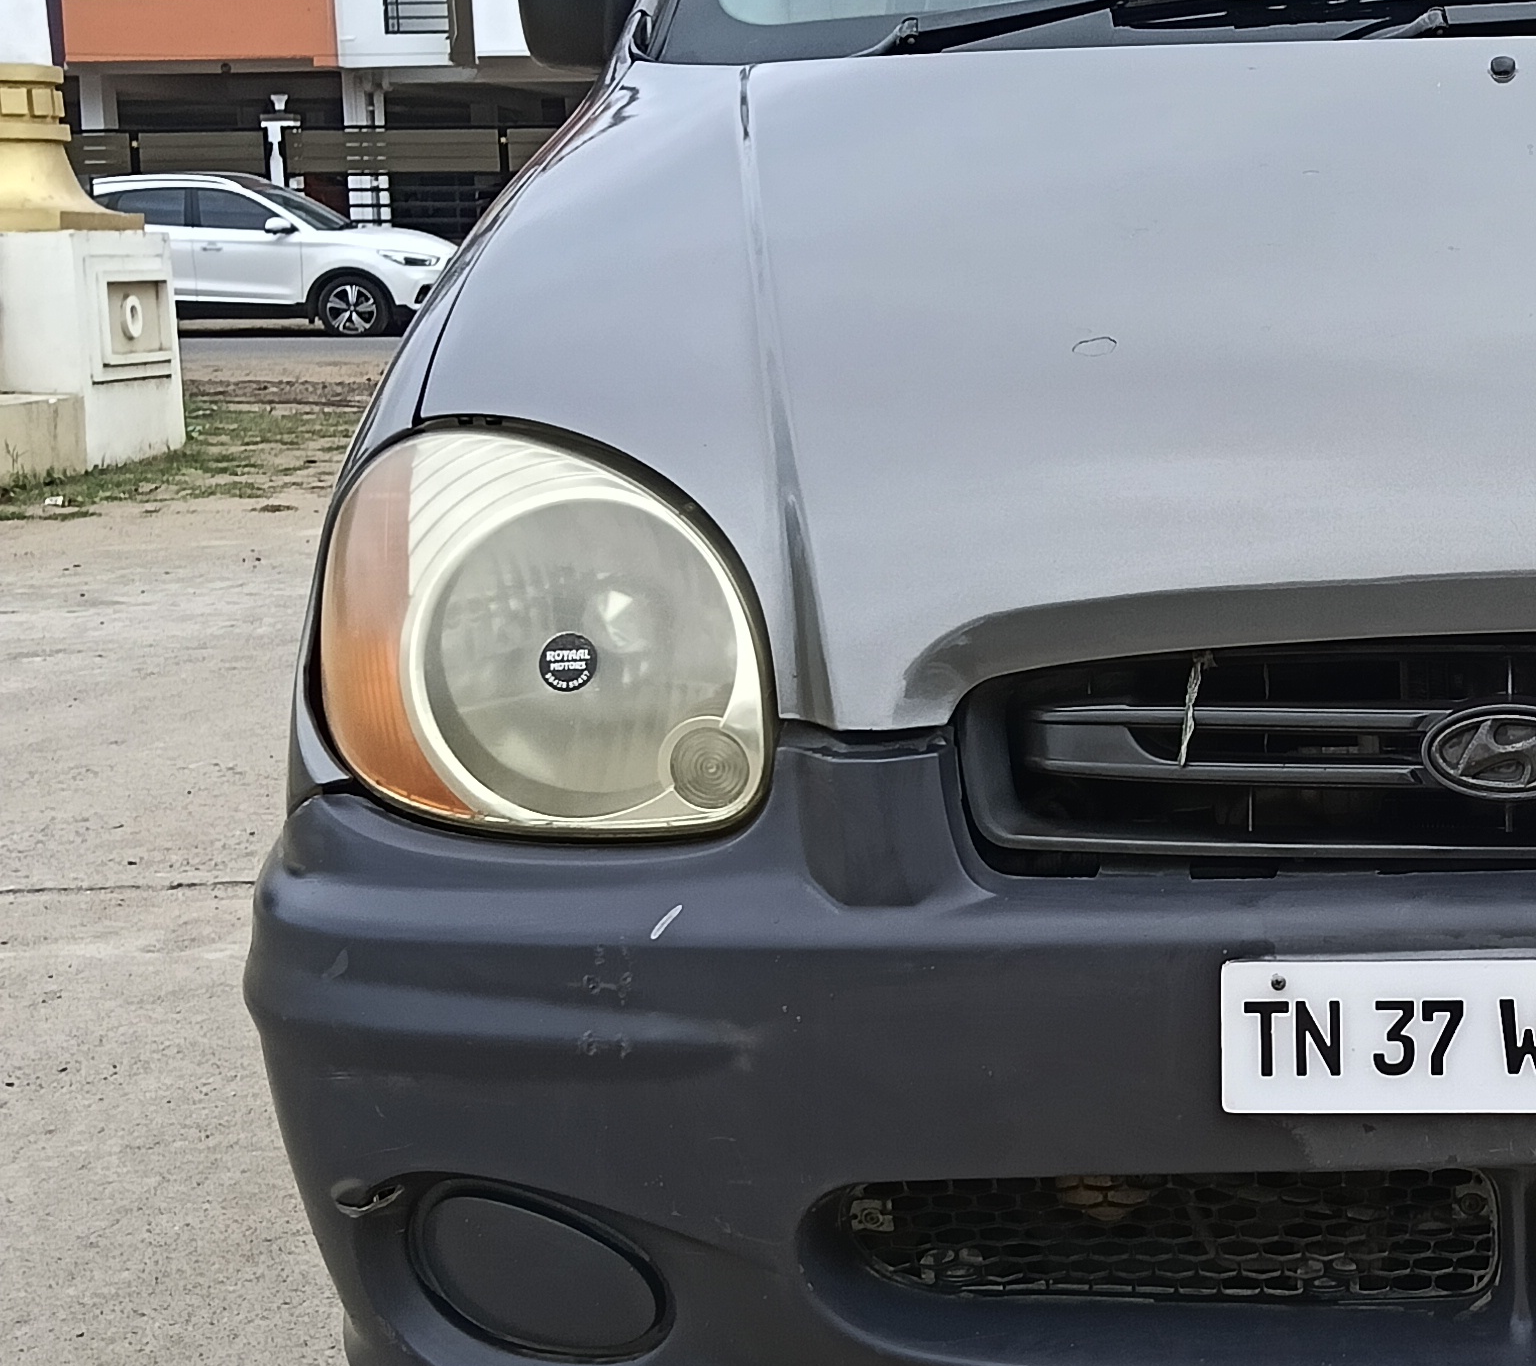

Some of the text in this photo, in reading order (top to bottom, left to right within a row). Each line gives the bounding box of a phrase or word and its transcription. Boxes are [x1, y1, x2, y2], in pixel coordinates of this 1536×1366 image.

[546, 649, 591, 662] ROYAAL
[550, 661, 586, 671] MOTORS
[1243, 1000, 1341, 1077] TN
[1372, 1000, 1465, 1077] 37
